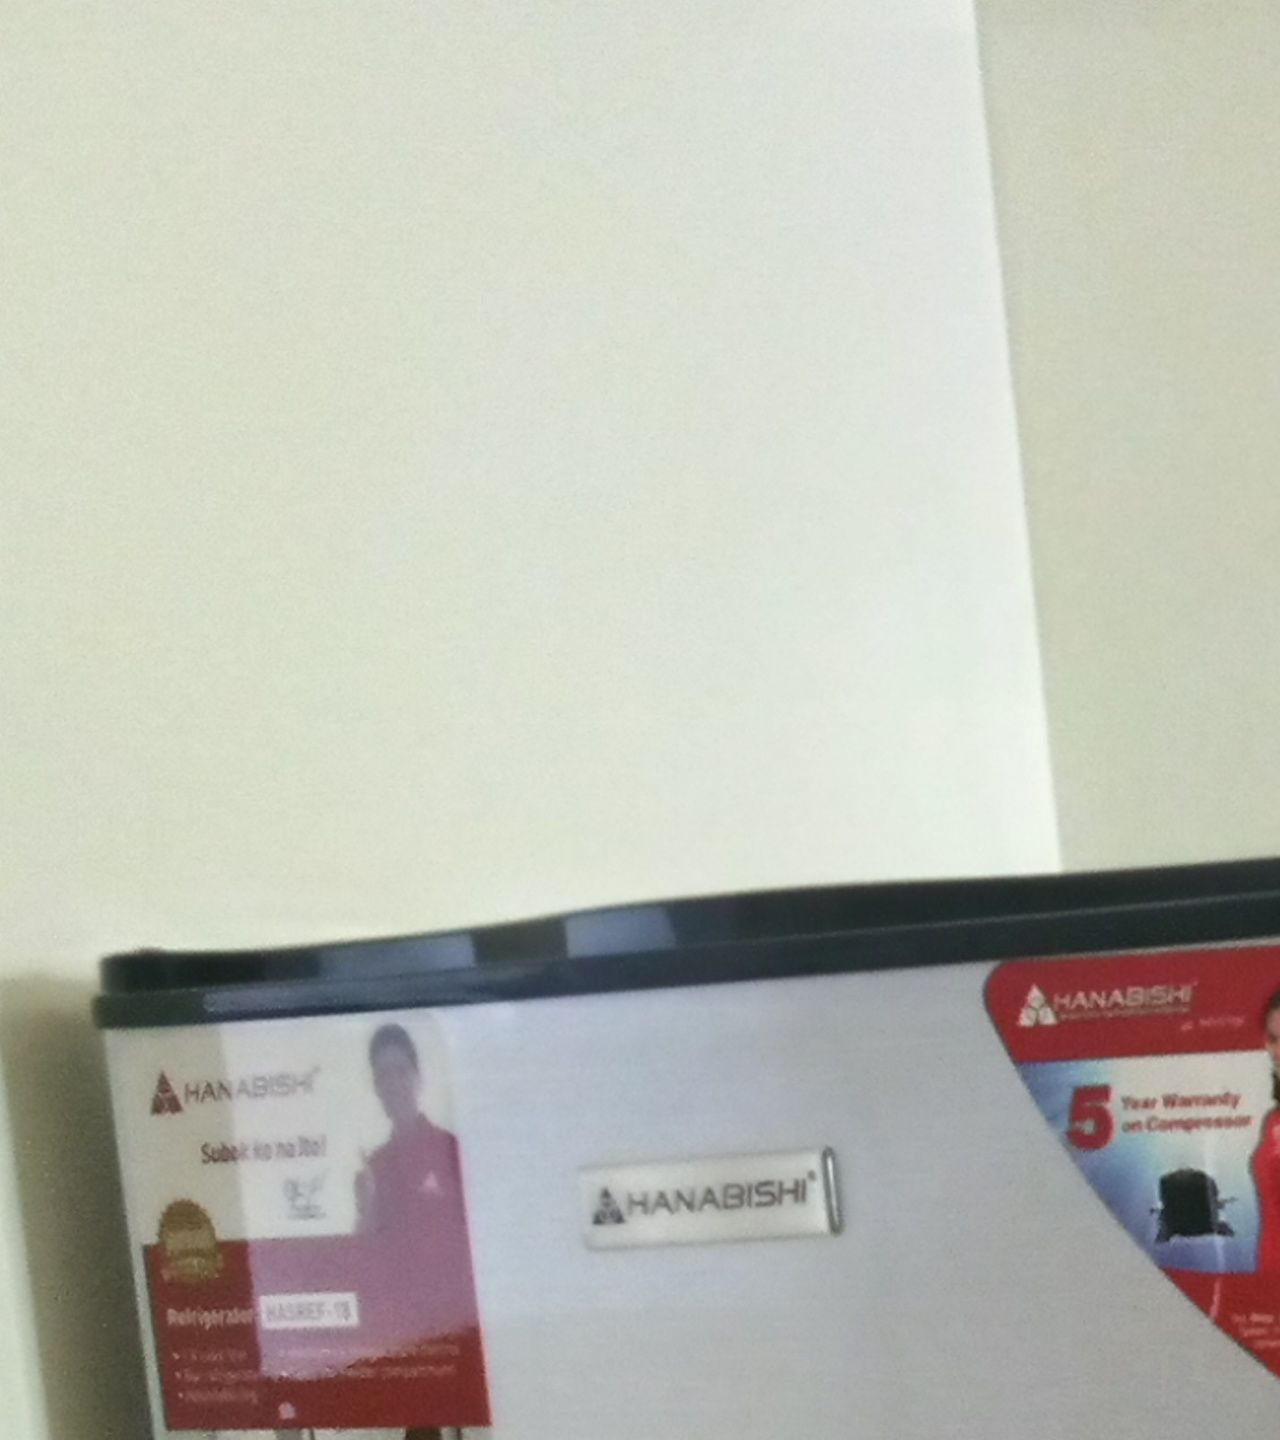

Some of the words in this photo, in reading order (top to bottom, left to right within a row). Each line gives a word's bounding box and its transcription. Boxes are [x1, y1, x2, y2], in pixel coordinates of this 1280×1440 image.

[1053, 985, 1191, 1010] HANABISHI
[184, 1073, 314, 1104] HANABISHI
[1121, 1096, 1157, 1111] Year
[1161, 1092, 1242, 1110] Warranty
[1066, 1083, 1115, 1151] 5
[1121, 1119, 1145, 1133] on
[1147, 1114, 1253, 1134] Compressor
[626, 1178, 807, 1217] HANABISHI
[166, 1307, 254, 1330] Refrigerator
